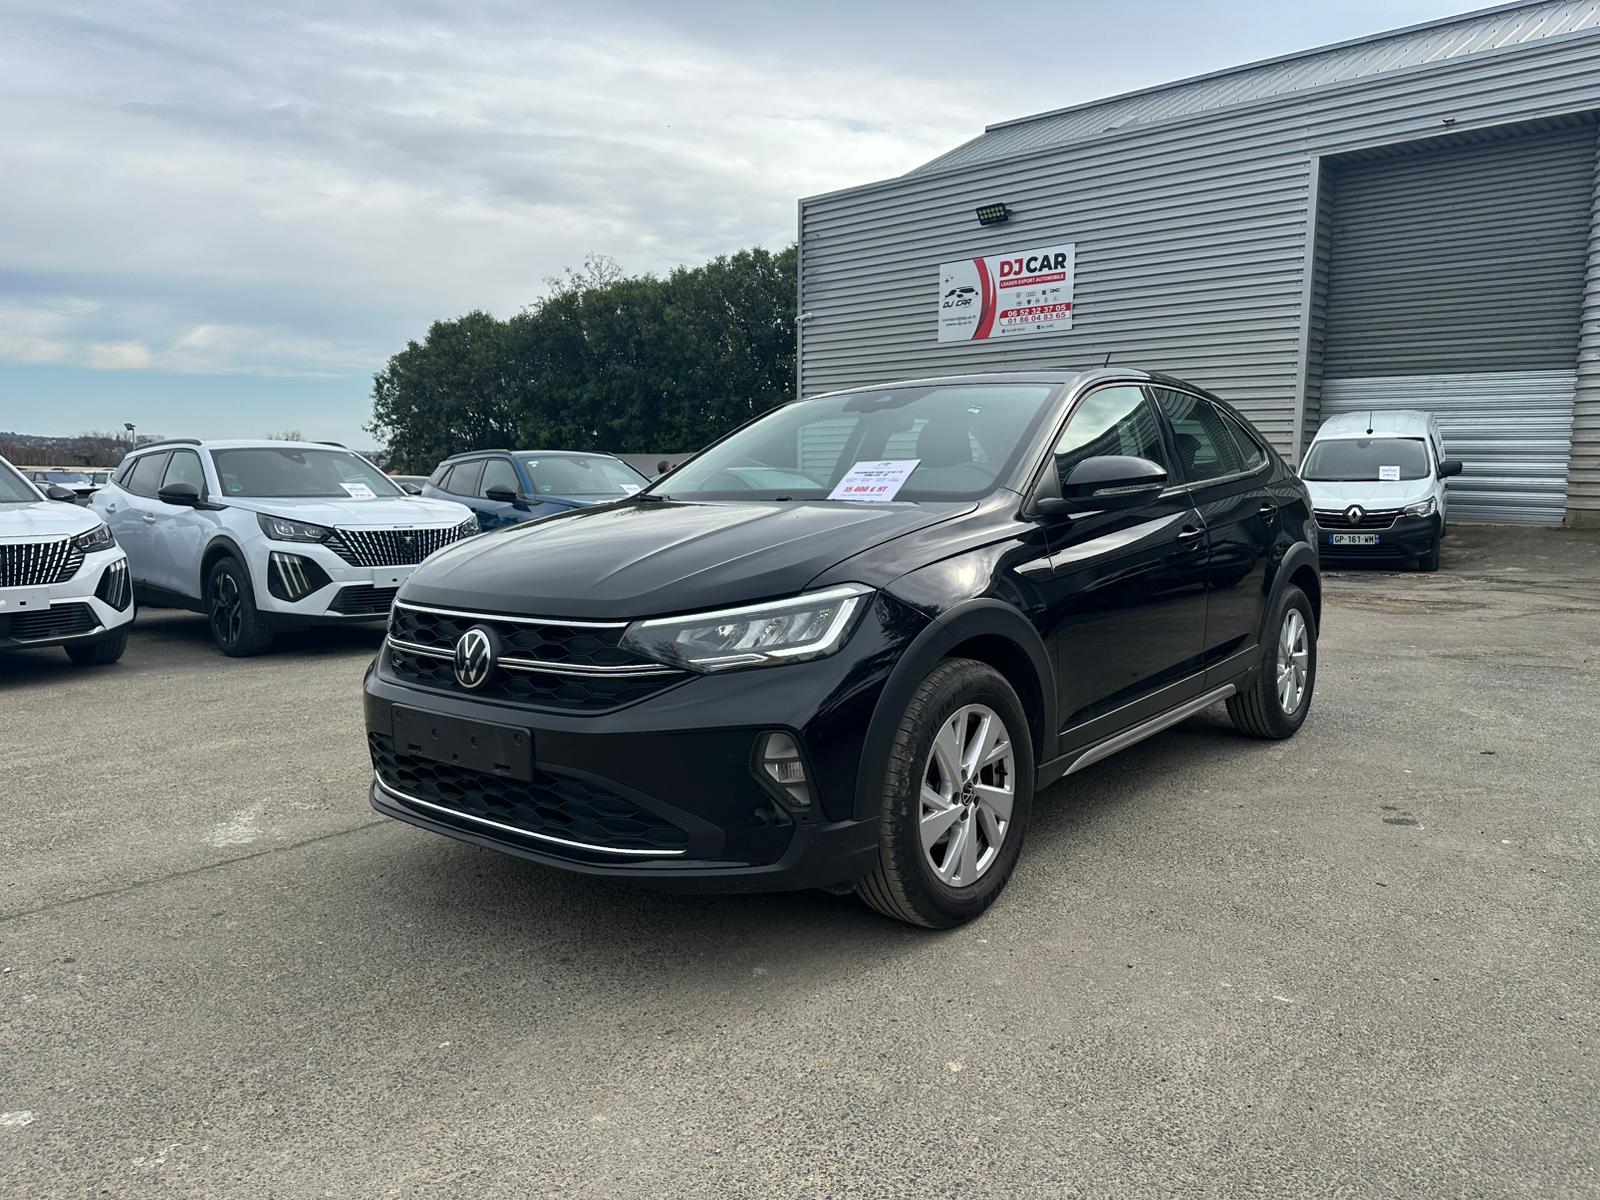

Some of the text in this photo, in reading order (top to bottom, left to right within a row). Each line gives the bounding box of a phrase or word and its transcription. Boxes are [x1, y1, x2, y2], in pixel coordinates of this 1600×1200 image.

[1000, 253, 1067, 278] DJ CAR
[1000, 273, 1065, 287] LEADER EXPORT AUTOMOBILE
[942, 298, 972, 308] DJ CAR
